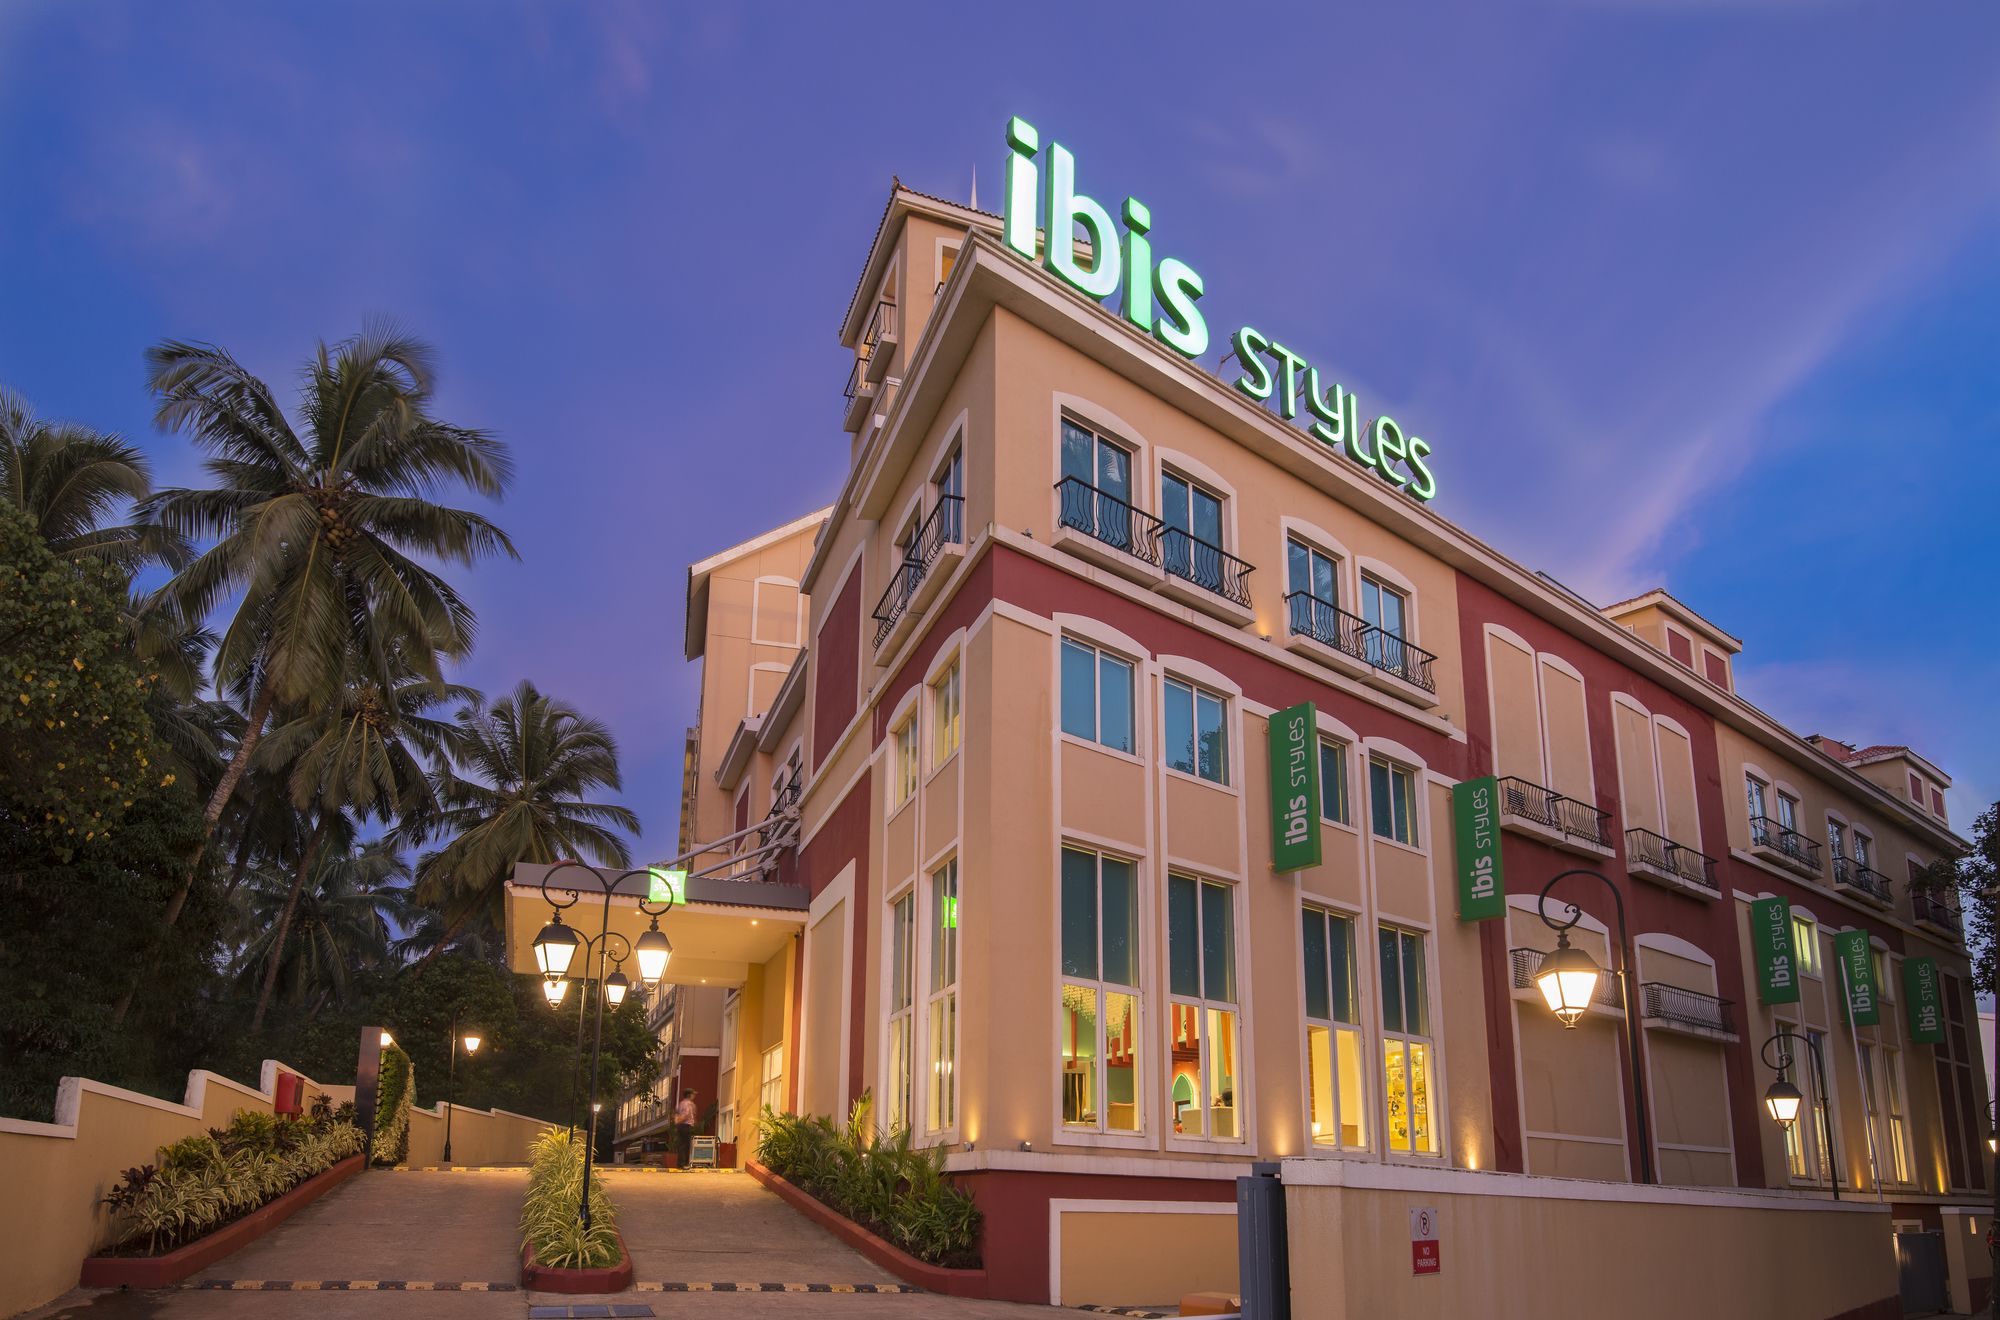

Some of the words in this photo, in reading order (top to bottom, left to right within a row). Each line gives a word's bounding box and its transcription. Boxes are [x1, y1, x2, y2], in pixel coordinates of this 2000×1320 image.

[1003, 115, 1209, 359] ibis
[1284, 794, 1308, 846] ibis
[1470, 855, 1495, 900] ibis
[1770, 955, 1790, 988] ibis
[1852, 983, 1872, 1013] ibis
[1918, 1005, 1937, 1031] ibis
[1417, 1258, 1437, 1267] PARKING
[1423, 1247, 1430, 1255] NO
